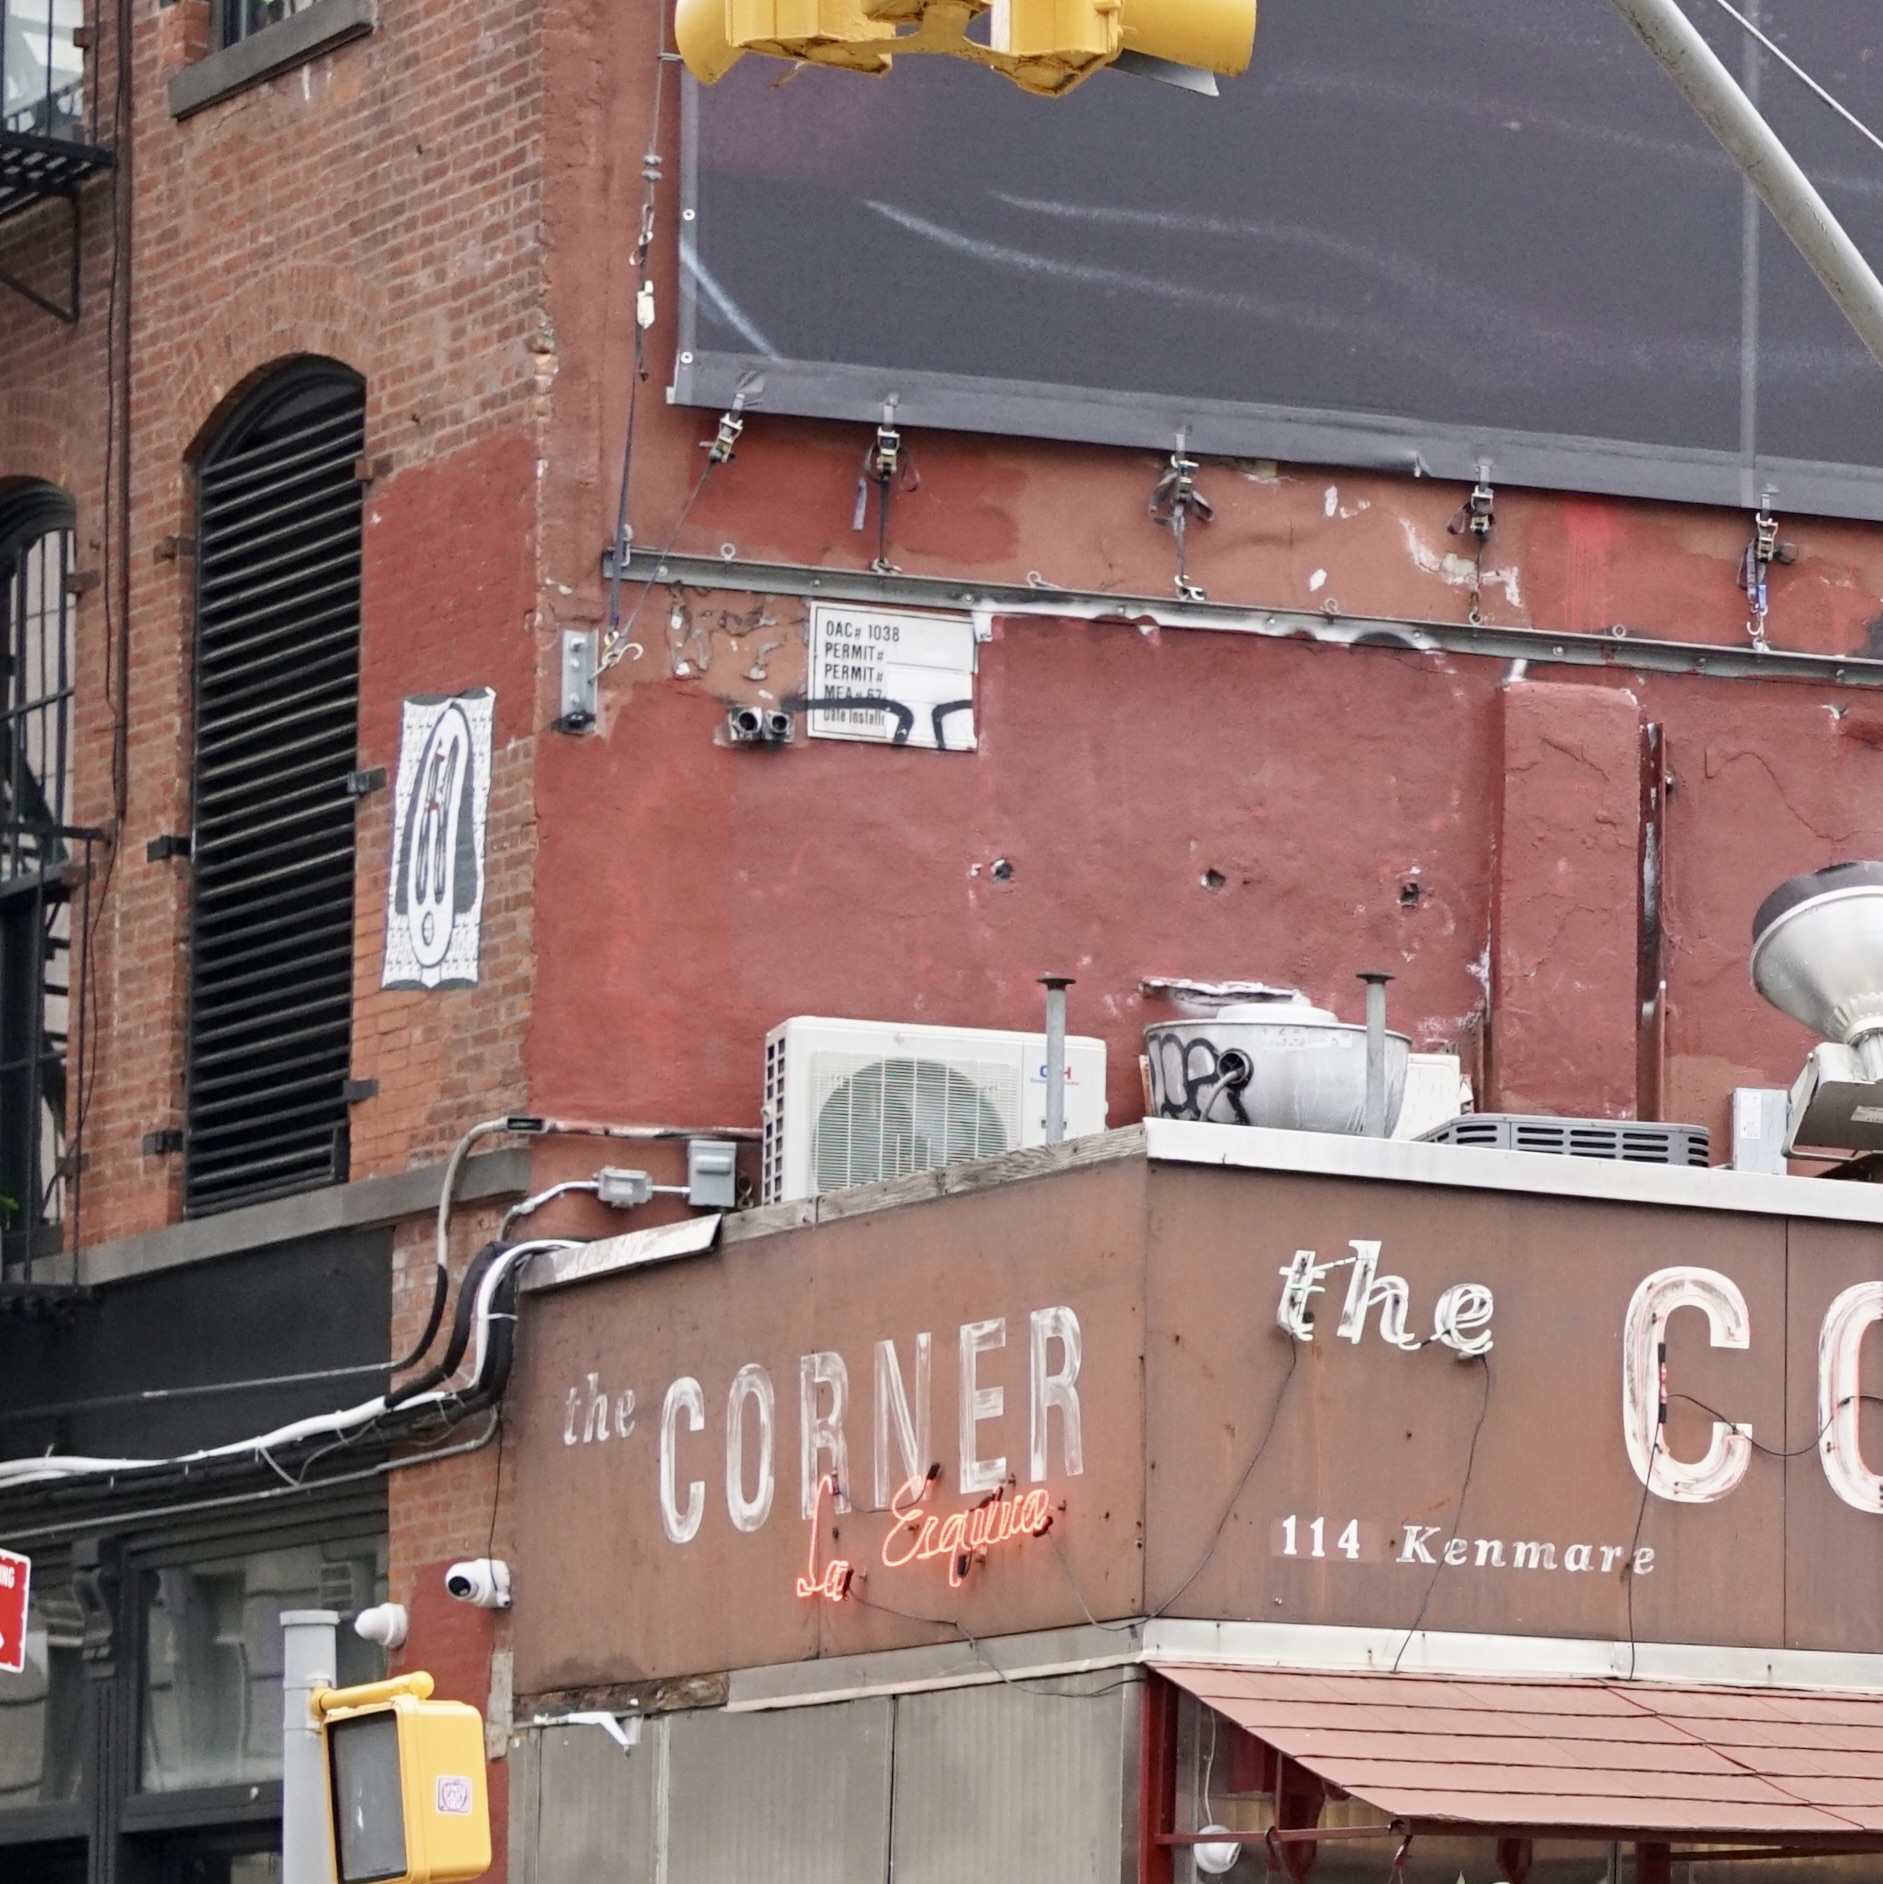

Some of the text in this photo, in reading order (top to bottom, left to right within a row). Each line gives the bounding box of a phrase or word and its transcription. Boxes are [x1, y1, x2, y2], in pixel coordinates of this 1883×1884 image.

[825, 642, 884, 661] PERMIT#
[868, 624, 900, 642] 1038
[825, 663, 884, 682] PERMIT#
[1275, 1239, 1494, 1361] the
[564, 1306, 1084, 1544] the CORNER
[797, 1474, 1051, 1602] La Esquina
[1282, 1514, 1655, 1576] 114 Kenmare
